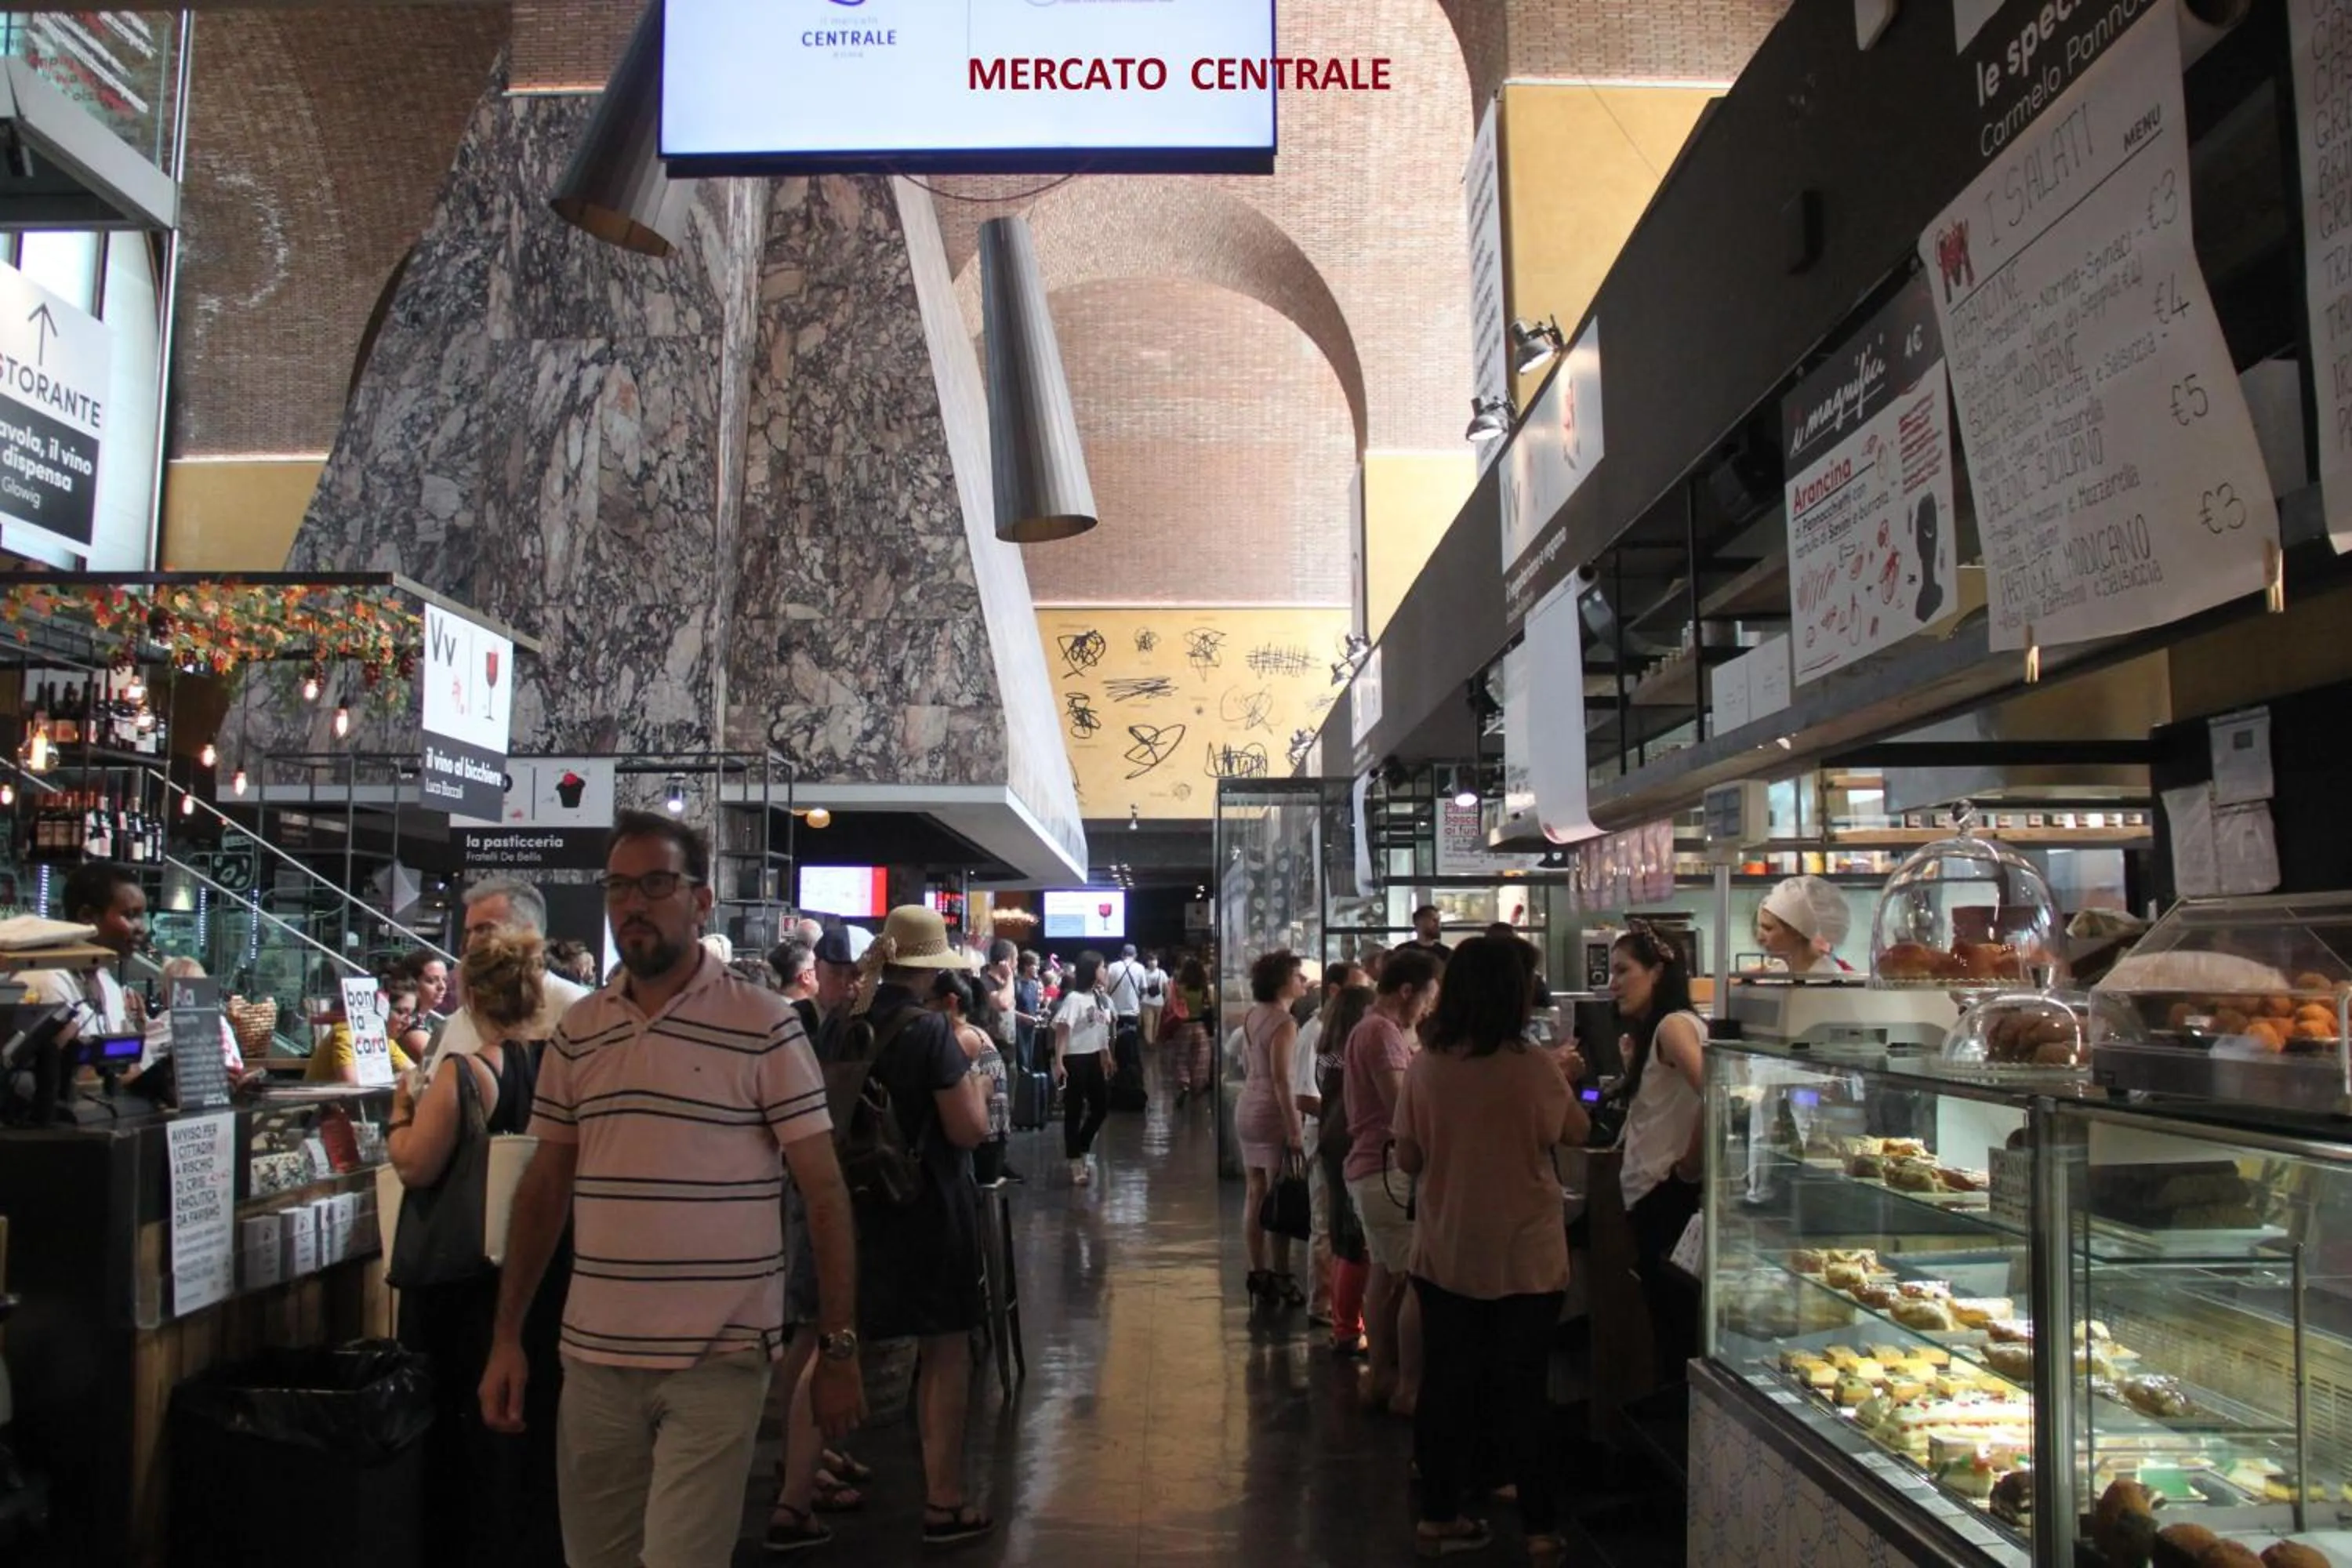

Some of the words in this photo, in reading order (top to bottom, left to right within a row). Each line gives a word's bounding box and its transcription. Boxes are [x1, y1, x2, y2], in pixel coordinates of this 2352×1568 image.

[802, 29, 897, 46] CENTRALE
[1976, 60, 2000, 108] le
[1979, 65, 2061, 157] Carmelo
[2123, 103, 2162, 153] MENU
[2005, 101, 2095, 227] SALATI
[2147, 168, 2178, 230] €3
[2151, 270, 2190, 325] €4
[2169, 373, 2209, 427] €5
[2, 444, 73, 492] dispensa
[49, 437, 60, 461] il
[61, 446, 93, 476] vino
[2, 476, 42, 509] Glowig
[1793, 457, 1852, 514] Arancina
[2198, 480, 2248, 535] €3
[430, 612, 456, 667] Vv
[434, 750, 453, 775] vino
[454, 756, 464, 778] al
[465, 756, 502, 787] bicchiere
[466, 834, 481, 848] la
[484, 834, 564, 851] pasticceria
[356, 1030, 387, 1054] card
[172, 1127, 201, 1142] AVVISO
[183, 1157, 215, 1173] RISCHIO
